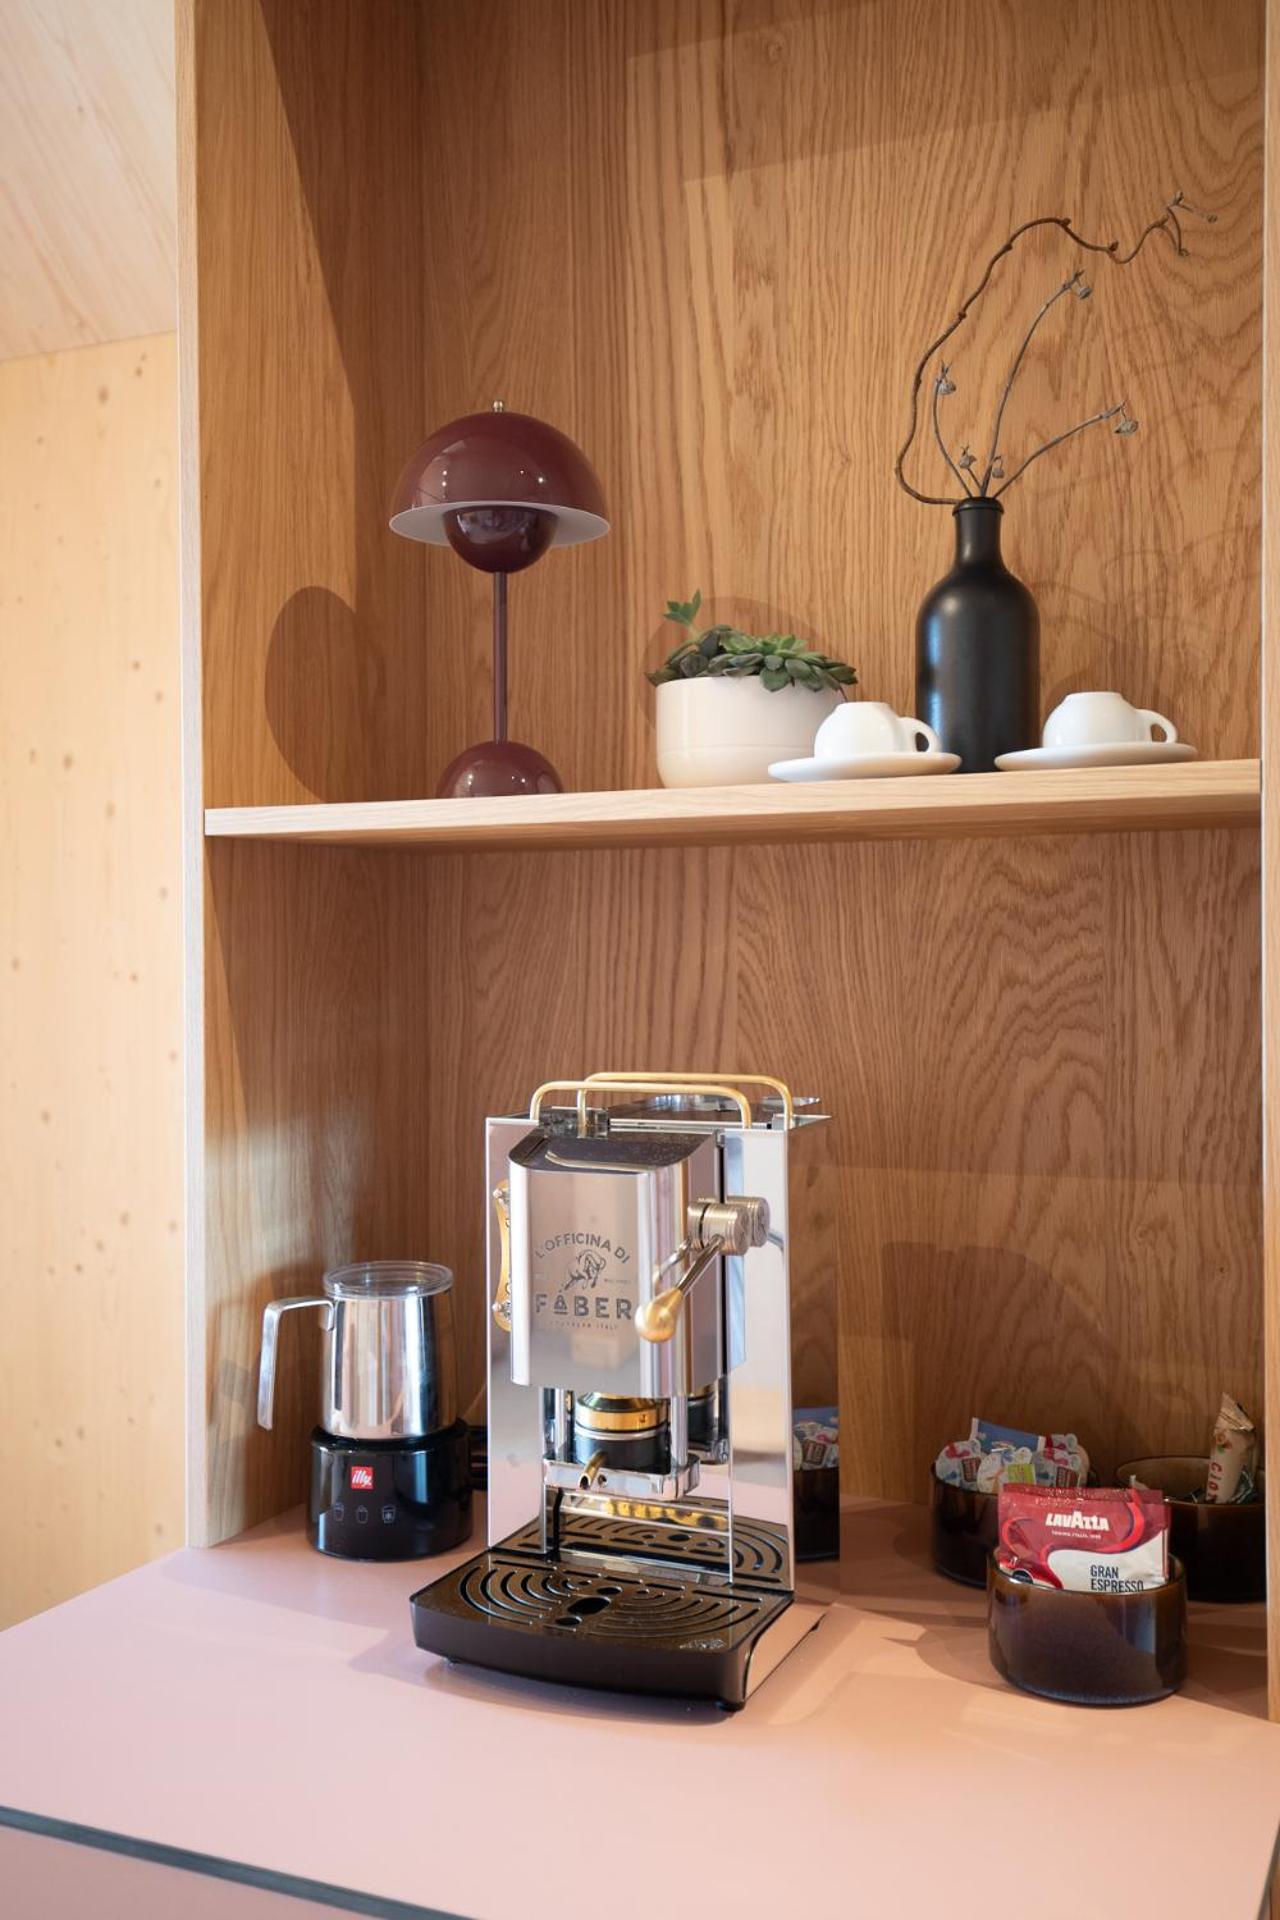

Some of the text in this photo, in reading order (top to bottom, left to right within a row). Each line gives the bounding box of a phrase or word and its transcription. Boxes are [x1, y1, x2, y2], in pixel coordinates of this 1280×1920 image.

[534, 1232, 631, 1264] L'OFFICINA DI
[351, 1470, 373, 1488] illy
[1045, 1510, 1110, 1531] LAVAZZA
[1090, 1564, 1119, 1579] GRAN
[1090, 1578, 1144, 1593] ESPRESSO
